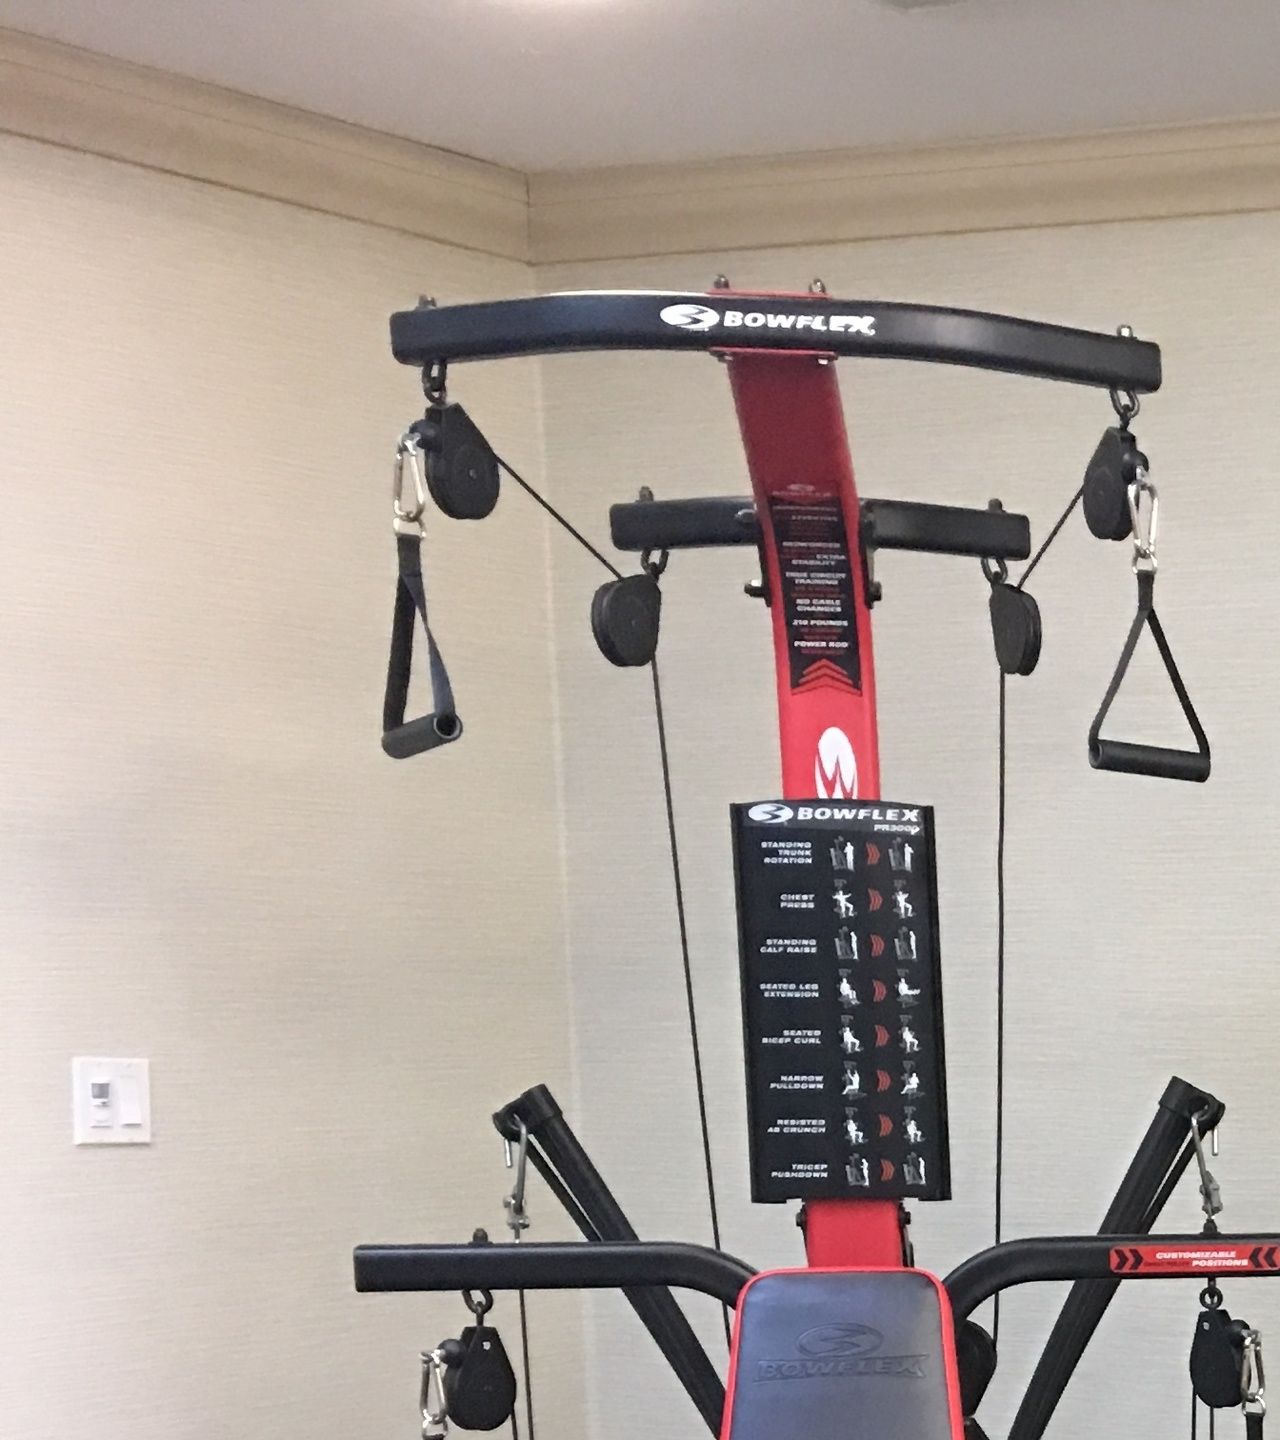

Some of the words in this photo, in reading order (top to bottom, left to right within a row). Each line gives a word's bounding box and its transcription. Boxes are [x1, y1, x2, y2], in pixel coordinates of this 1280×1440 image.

[723, 310, 875, 336] BOWFLEX
[794, 640, 827, 648] POWER
[797, 806, 920, 822] BOWFLEX
[761, 841, 812, 849] STANDING
[780, 893, 816, 901] CHEST
[780, 901, 815, 909] PRESS
[766, 938, 817, 946] STANDING
[764, 990, 820, 998] EXTENSION
[1155, 1250, 1237, 1260] CUSTOMIZABLE
[1191, 1259, 1249, 1267] POSITIONS
[756, 1355, 926, 1380] BOWFLEX
